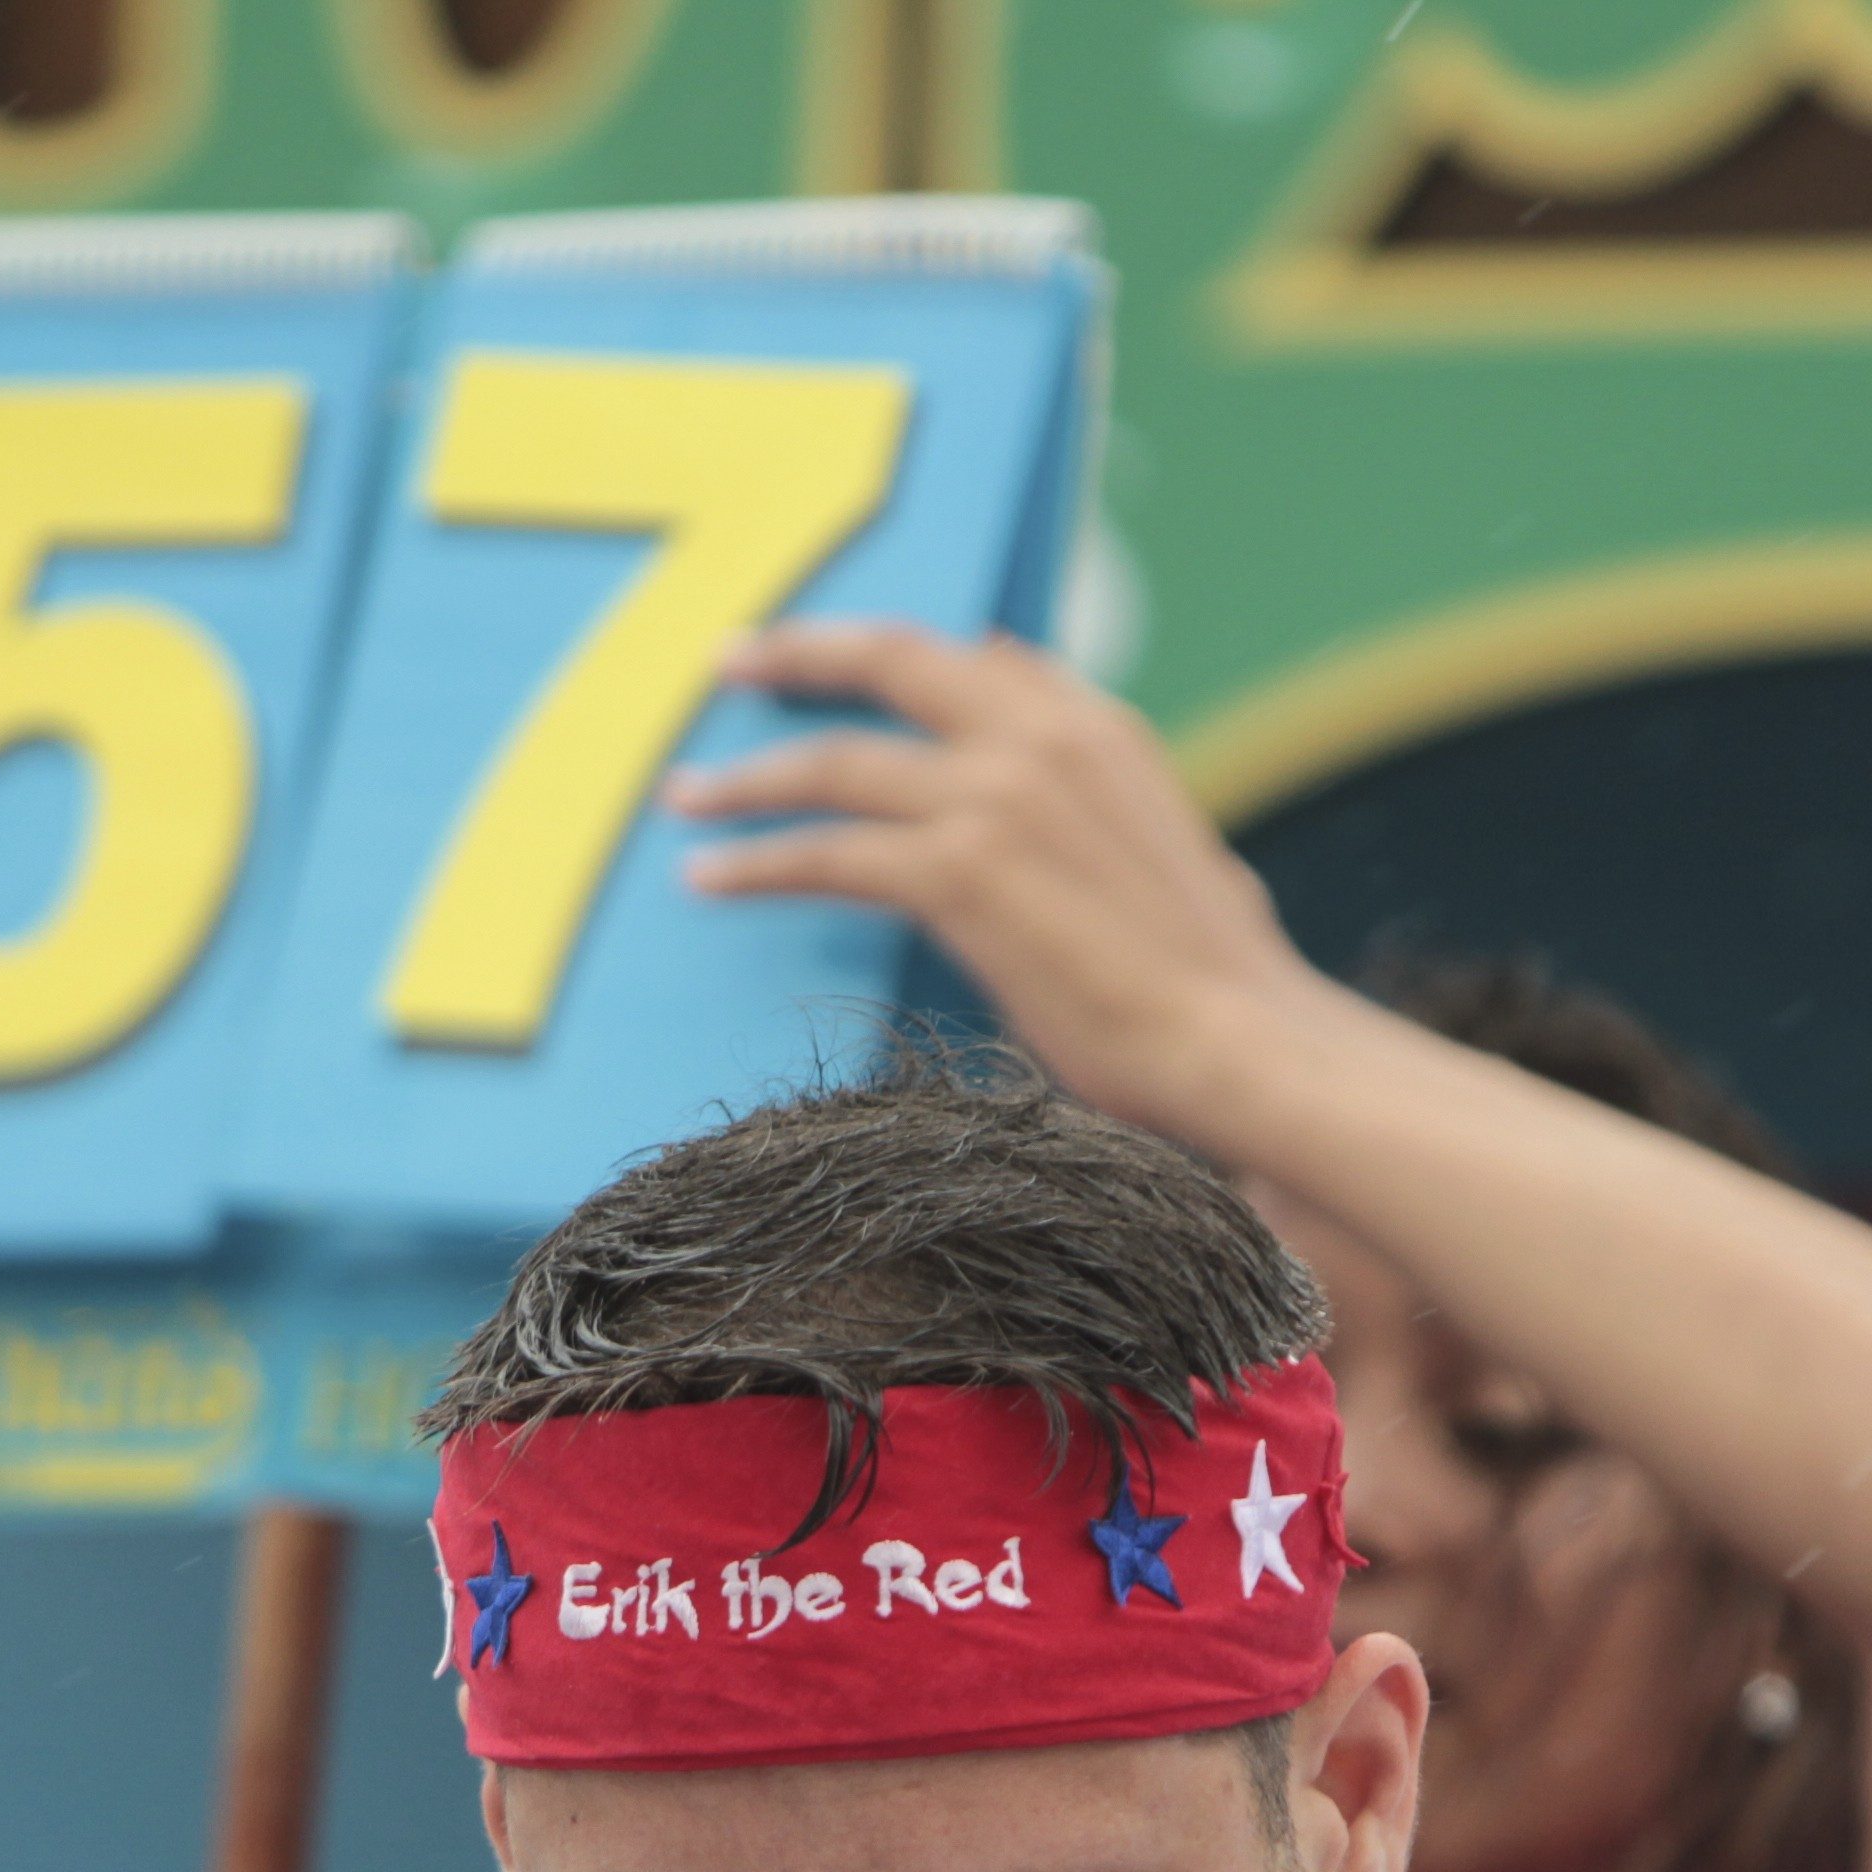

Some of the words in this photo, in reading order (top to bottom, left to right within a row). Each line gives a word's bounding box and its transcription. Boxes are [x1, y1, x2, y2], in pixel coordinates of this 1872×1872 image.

[560, 1558, 699, 1640] Erik
[722, 1557, 847, 1640] the
[863, 1536, 1031, 1618] Red
